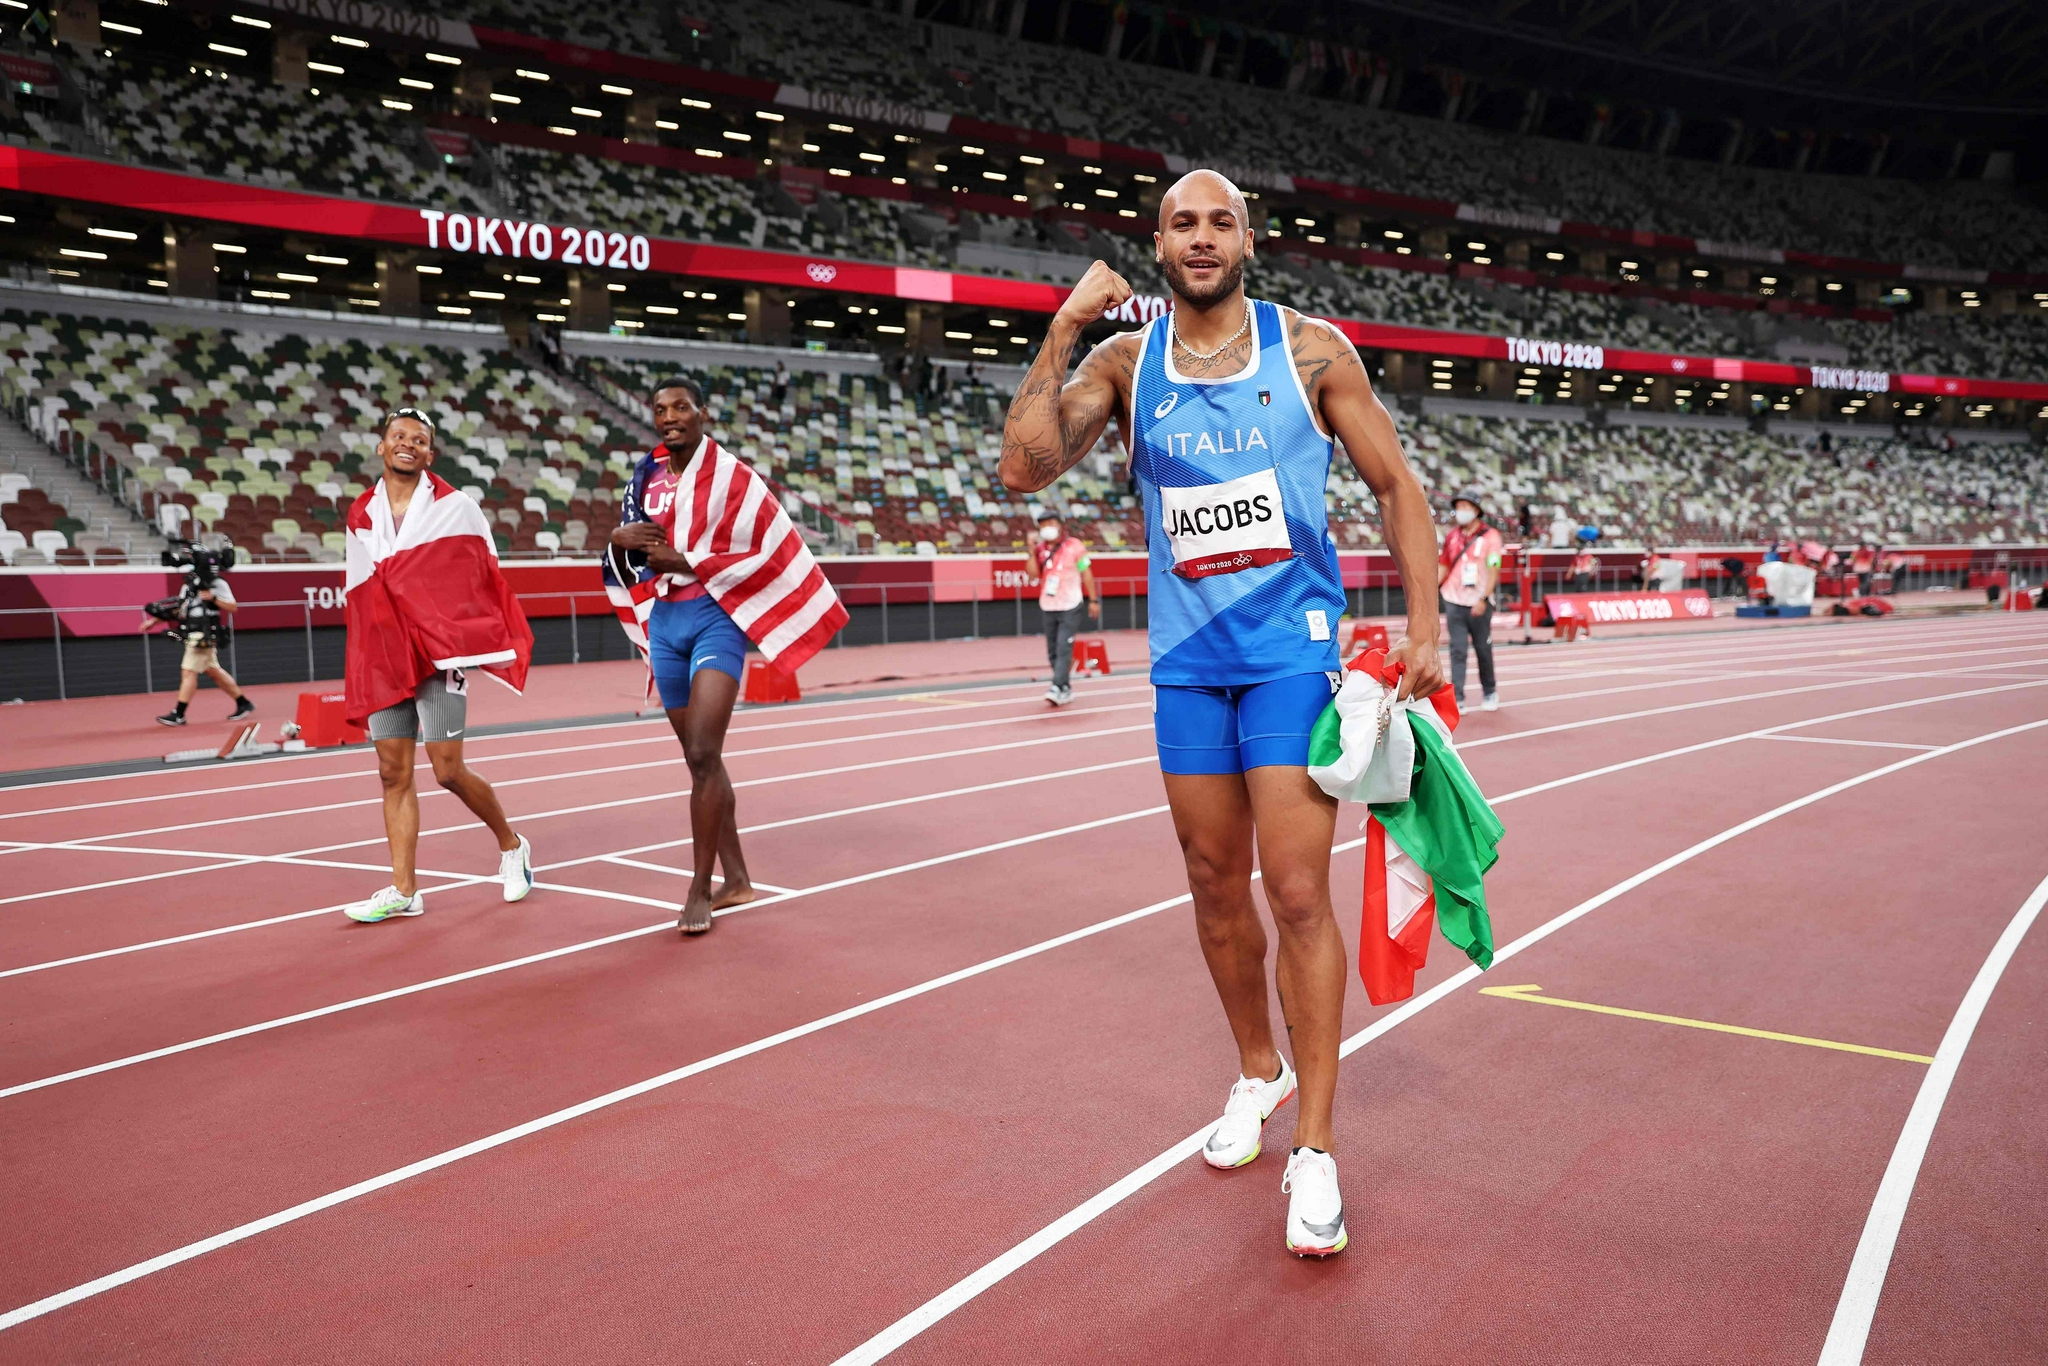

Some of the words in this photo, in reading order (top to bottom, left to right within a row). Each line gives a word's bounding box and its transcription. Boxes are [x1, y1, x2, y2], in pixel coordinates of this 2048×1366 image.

[372, 6, 440, 41] 2020
[877, 101, 925, 129] 2020
[420, 209, 552, 261] TOKYO
[561, 227, 650, 271] 2020
[1506, 337, 1562, 366] TOKYO
[1563, 343, 1604, 370] 2020
[1810, 366, 1856, 391] TOKYO
[1856, 370, 1890, 393] 2020
[1167, 427, 1268, 457] ITALIA
[1170, 495, 1272, 537] JACOBS
[1196, 562, 1216, 571] TOKYO
[1216, 560, 1232, 569] 2020
[1588, 600, 1638, 622] TOKYO
[1637, 598, 1673, 620] 2020
